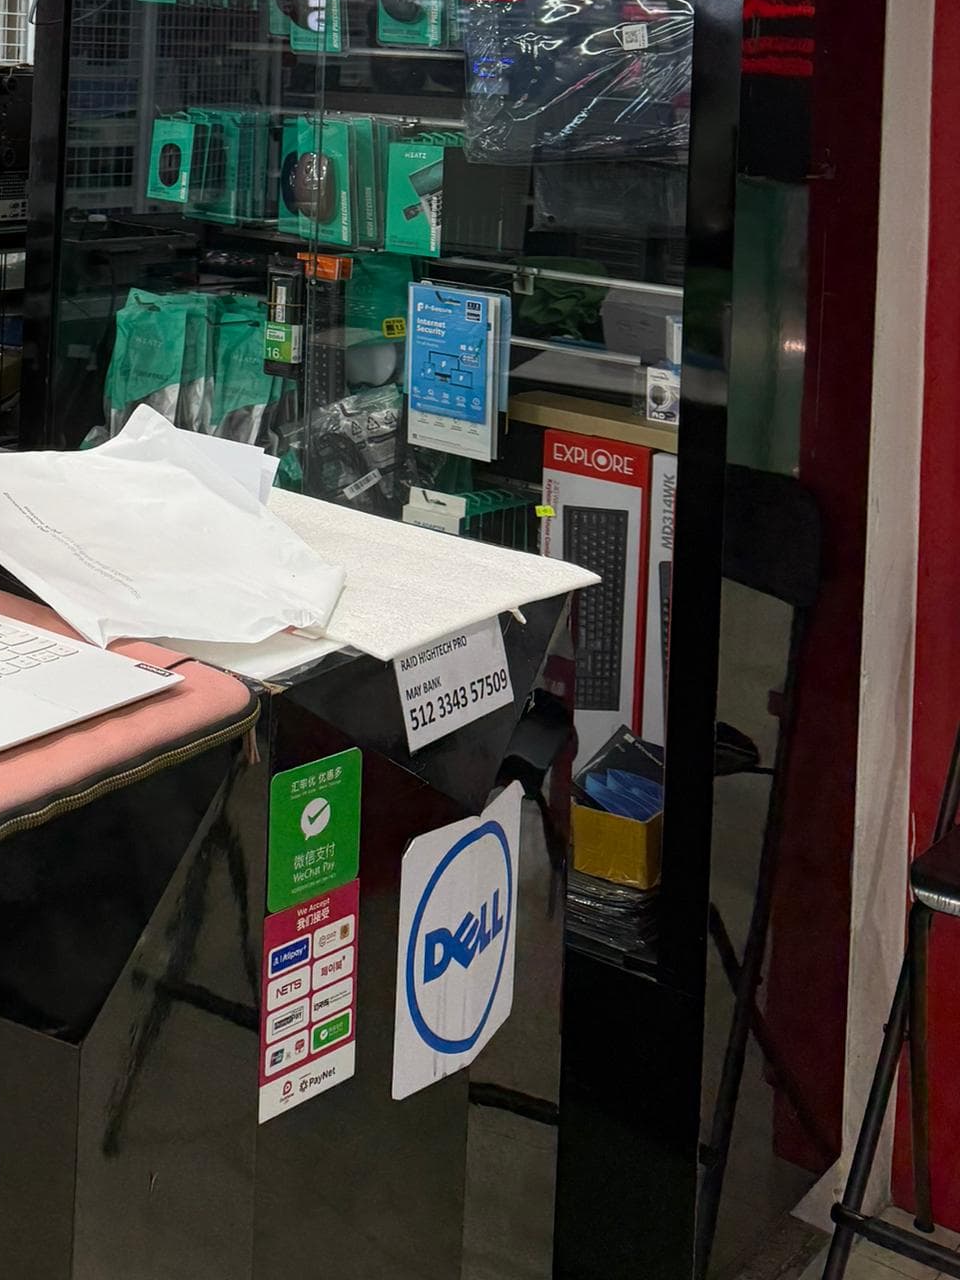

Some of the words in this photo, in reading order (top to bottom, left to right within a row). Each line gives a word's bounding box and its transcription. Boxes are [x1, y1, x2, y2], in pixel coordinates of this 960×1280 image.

[416, 317, 446, 329] Internet
[416, 324, 446, 337] Security
[553, 442, 635, 476] EXPLORE
[660, 473, 676, 551] MD314WK
[400, 655, 418, 672] RAID
[418, 641, 452, 664] HIGHTECH
[452, 635, 467, 649] PRO
[406, 684, 422, 701] MAY
[423, 675, 442, 694] BANK
[409, 700, 436, 731] 512
[437, 686, 468, 718] 3343
[470, 669, 508, 703] 57509
[294, 841, 336, 870] 微信支付
[293, 865, 321, 883] WeChat
[323, 860, 336, 874] Pay
[296, 906, 308, 917] We
[308, 898, 330, 912] Accept
[296, 906, 330, 932] 我们接受
[423, 888, 504, 985] DELL
[276, 978, 302, 999] NETS
[309, 1066, 336, 1087] PayNet
